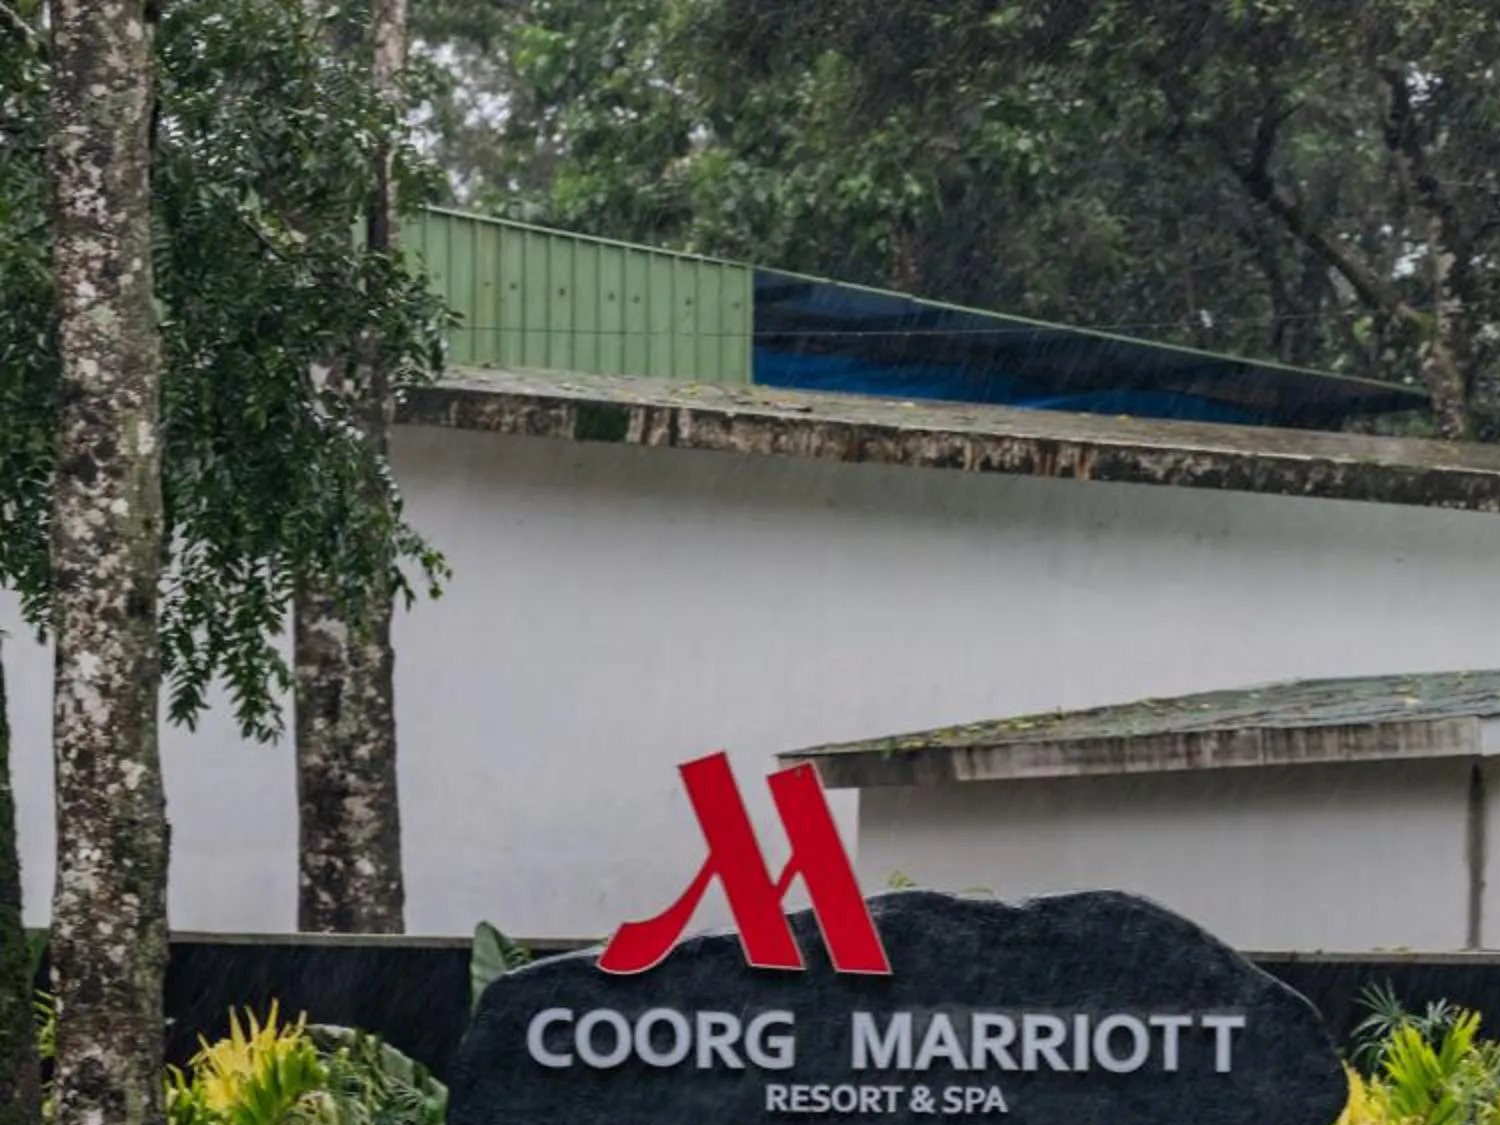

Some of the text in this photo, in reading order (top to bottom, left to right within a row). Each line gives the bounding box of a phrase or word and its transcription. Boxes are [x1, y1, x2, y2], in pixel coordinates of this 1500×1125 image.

[527, 1006, 1247, 1074] COORG MARRIOTT
[765, 1084, 1009, 1114] RESORT & SPA
